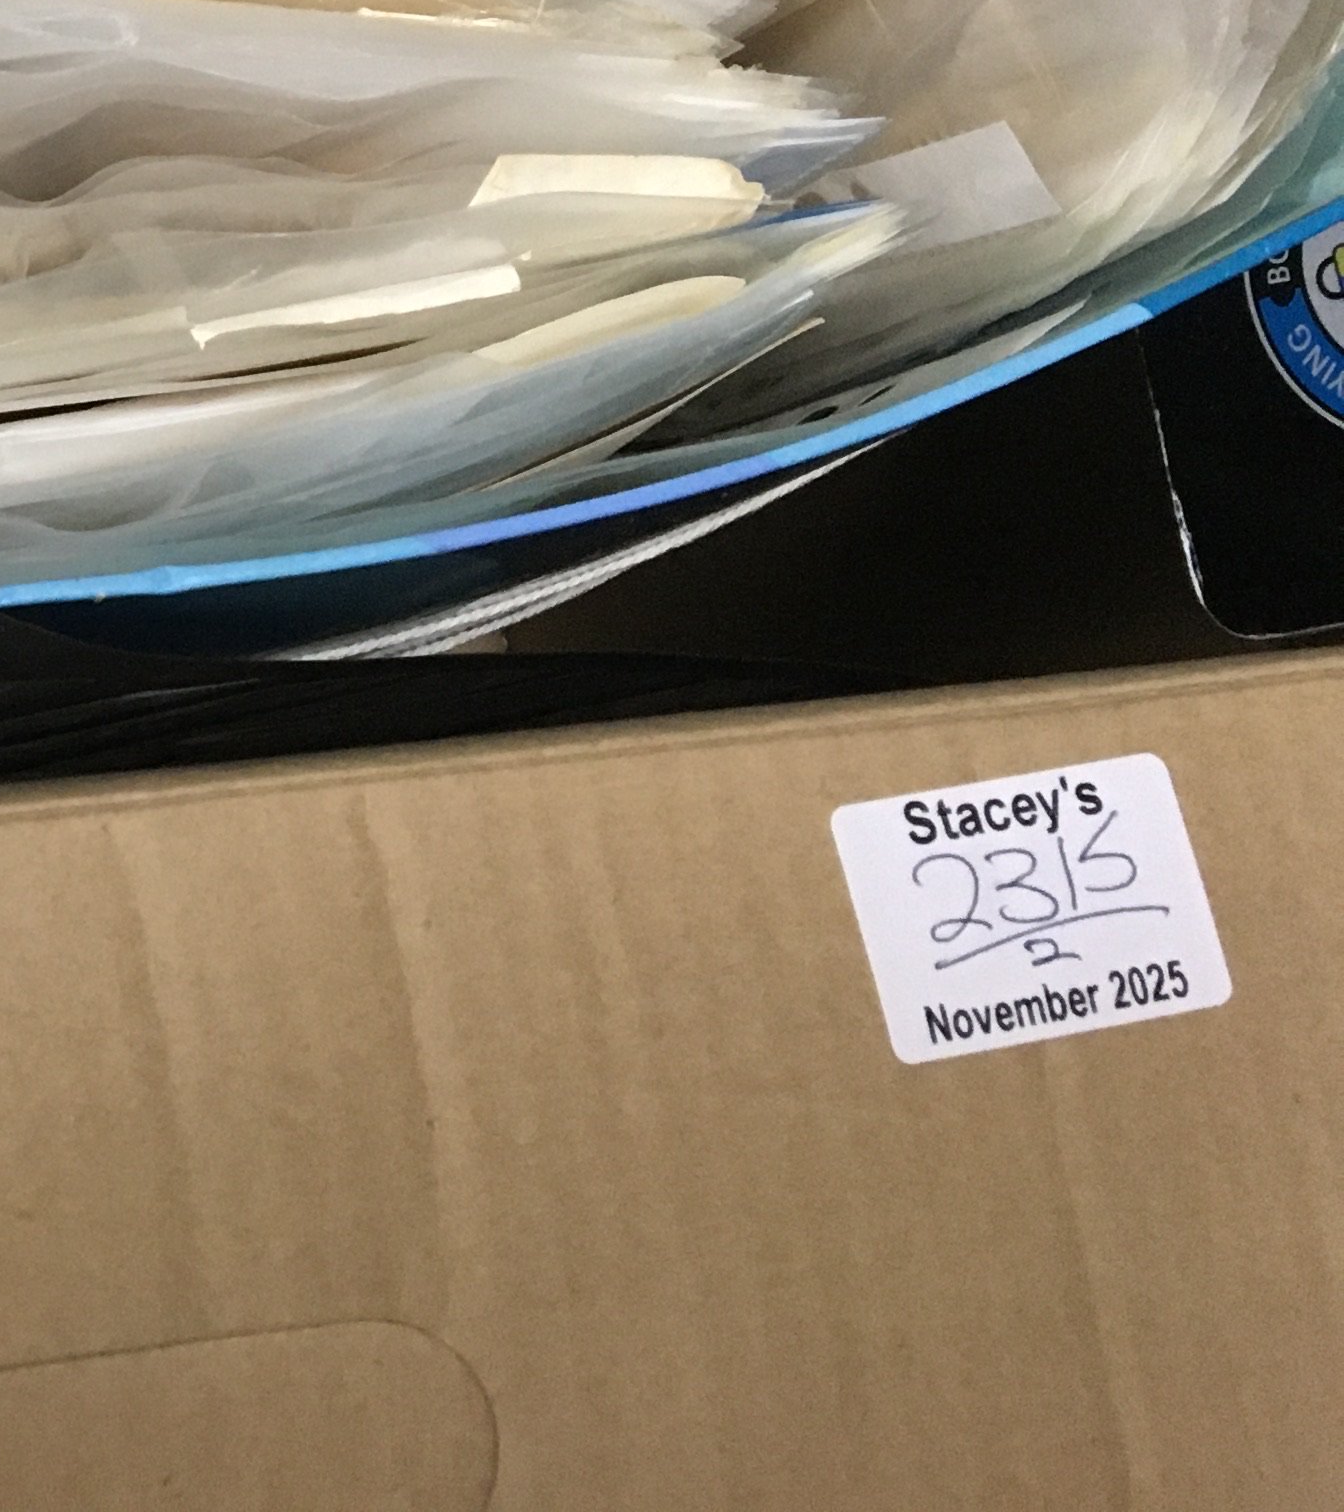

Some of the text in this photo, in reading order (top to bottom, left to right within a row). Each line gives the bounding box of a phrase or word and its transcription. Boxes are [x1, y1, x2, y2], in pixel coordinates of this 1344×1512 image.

[903, 776, 1103, 844] Stacey's
[912, 810, 1137, 942] 2315
[1024, 938, 1081, 966] 2
[924, 960, 1189, 1043] November 2025
